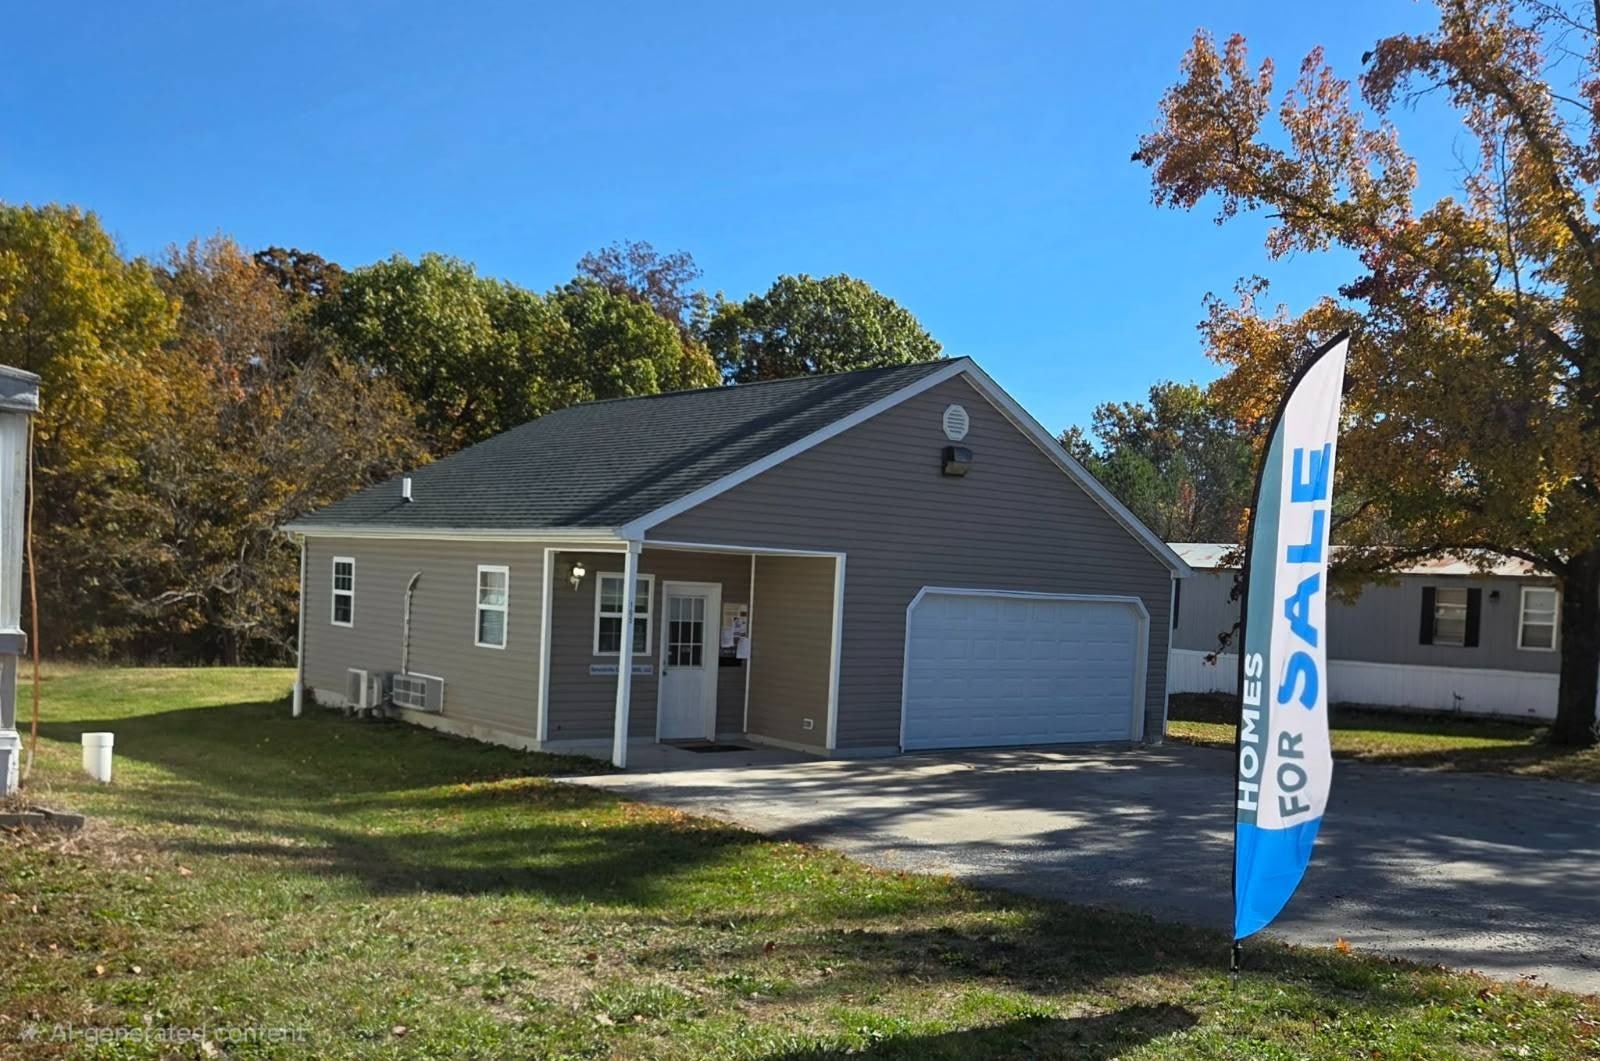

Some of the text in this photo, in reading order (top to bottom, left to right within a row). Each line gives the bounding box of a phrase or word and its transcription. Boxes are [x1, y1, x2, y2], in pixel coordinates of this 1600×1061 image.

[1238, 652, 1263, 811] HOMES
[1277, 443, 1331, 818] FOR SALE
